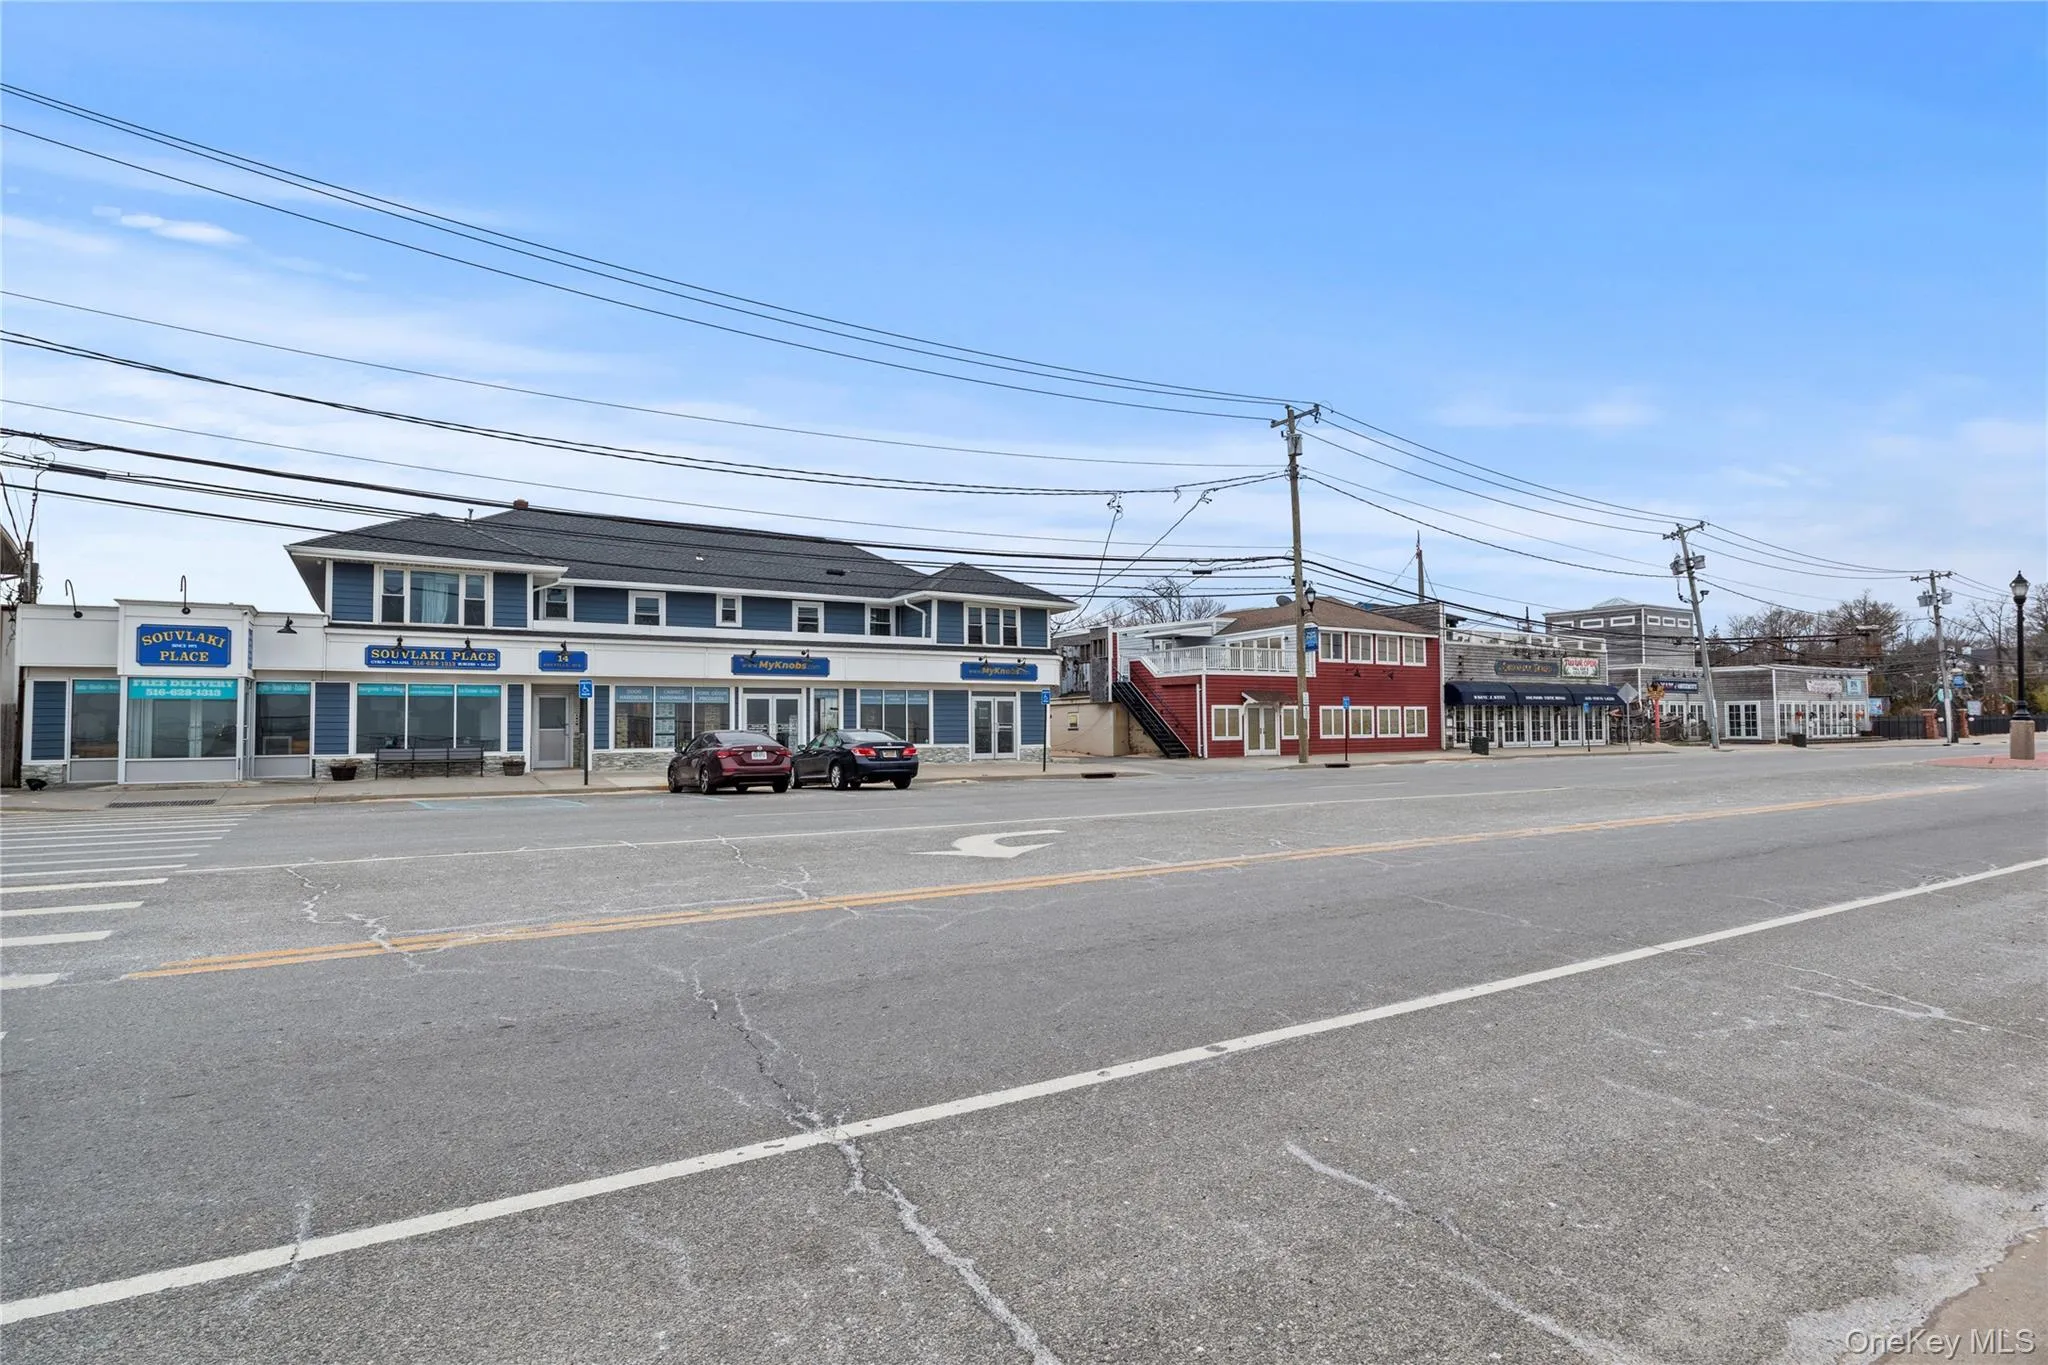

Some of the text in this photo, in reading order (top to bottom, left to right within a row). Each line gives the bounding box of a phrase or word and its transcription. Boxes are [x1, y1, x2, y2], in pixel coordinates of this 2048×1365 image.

[141, 630, 226, 649] SOUVLAKI
[160, 650, 209, 662] PLACE
[371, 649, 496, 662] SOUVLAKI PLACE
